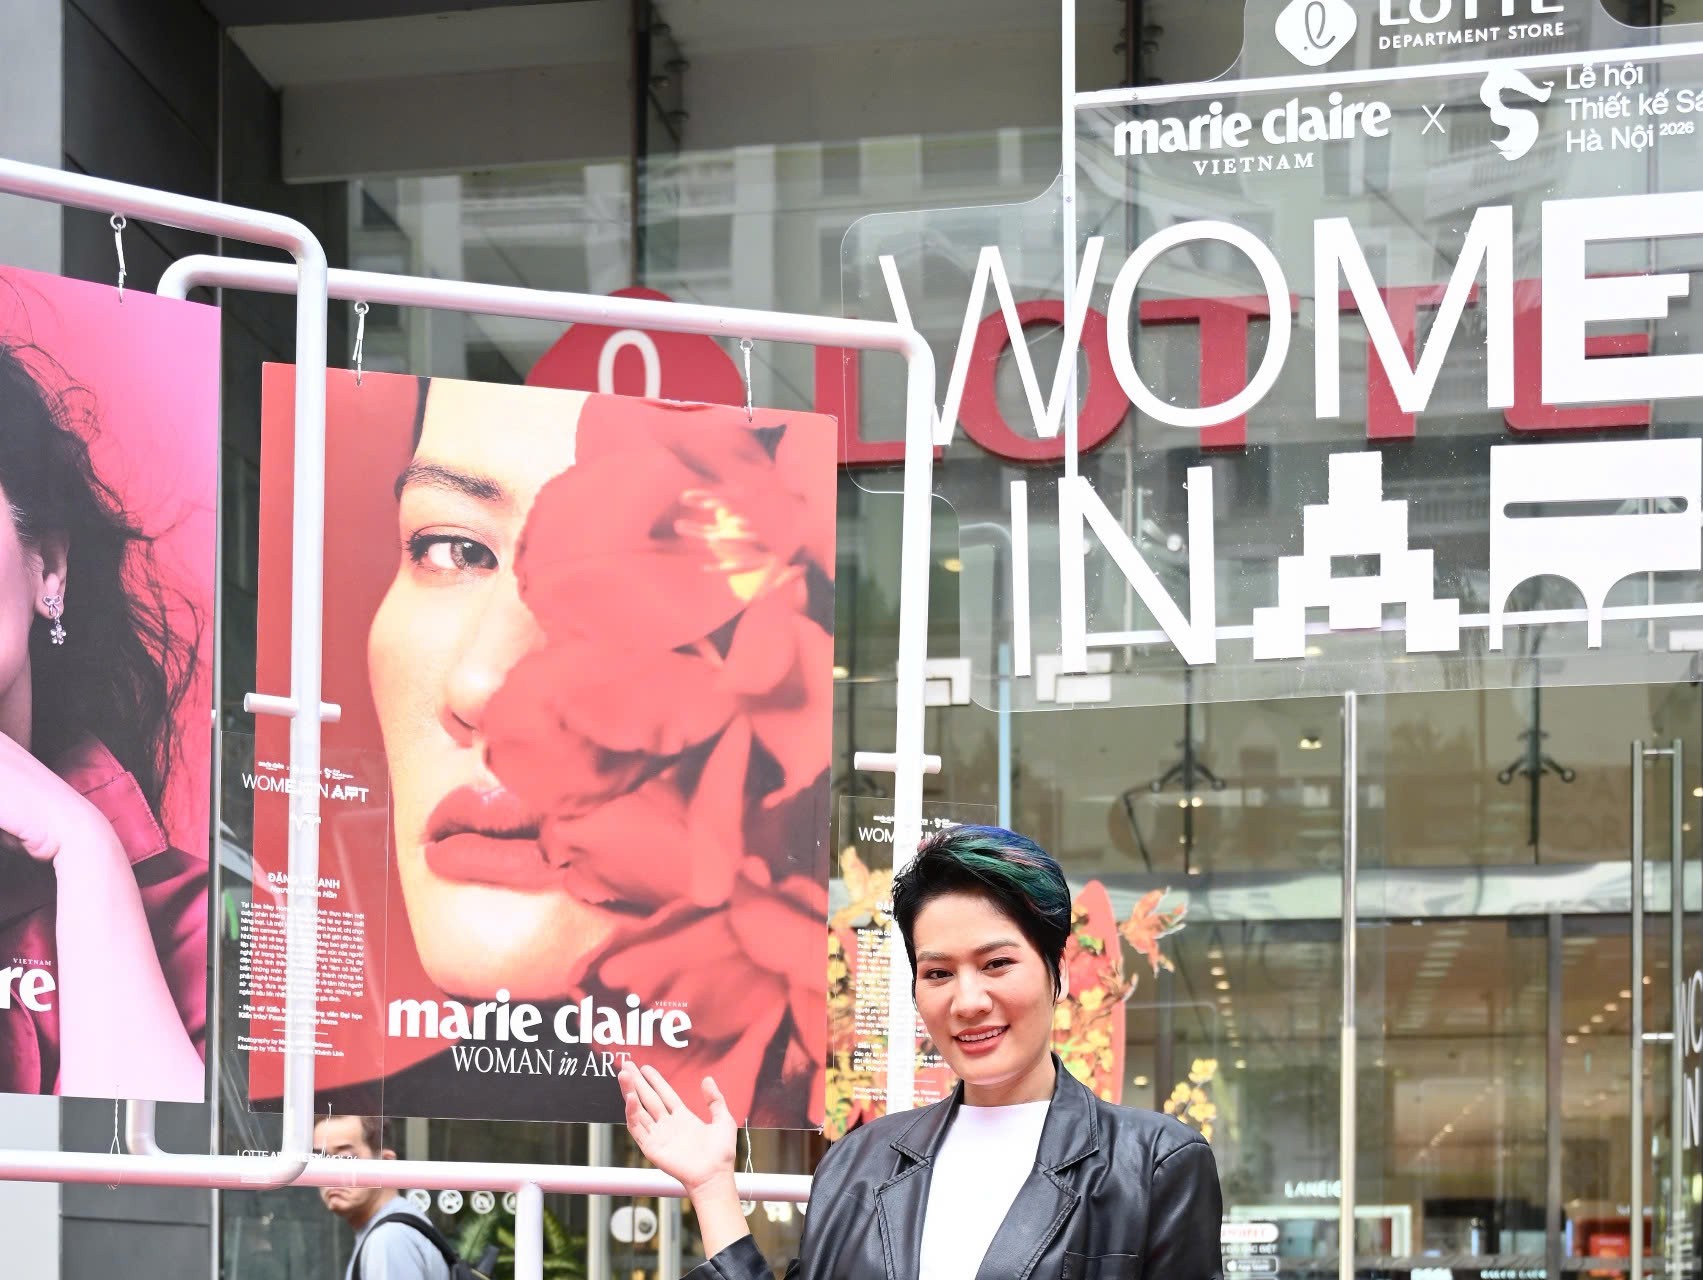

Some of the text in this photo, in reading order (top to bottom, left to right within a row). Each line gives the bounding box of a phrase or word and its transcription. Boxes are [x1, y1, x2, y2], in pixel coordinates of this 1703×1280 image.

[1379, 22, 1564, 50] DEPARTMENT STORE
[1604, 62, 1644, 88] hội
[1565, 89, 1631, 122] Thiết
[1638, 87, 1669, 117] kế
[1113, 101, 1252, 157] marie
[1262, 91, 1392, 145] claire
[1565, 121, 1695, 154] Hà Nội 2026
[1193, 152, 1315, 176] VIETNAM
[1011, 464, 1216, 678] IN
[13, 957, 52, 967] VIETNAM
[388, 988, 693, 1049] marie claire
[450, 1045, 554, 1077] WOMAN
[558, 1051, 578, 1077] in
